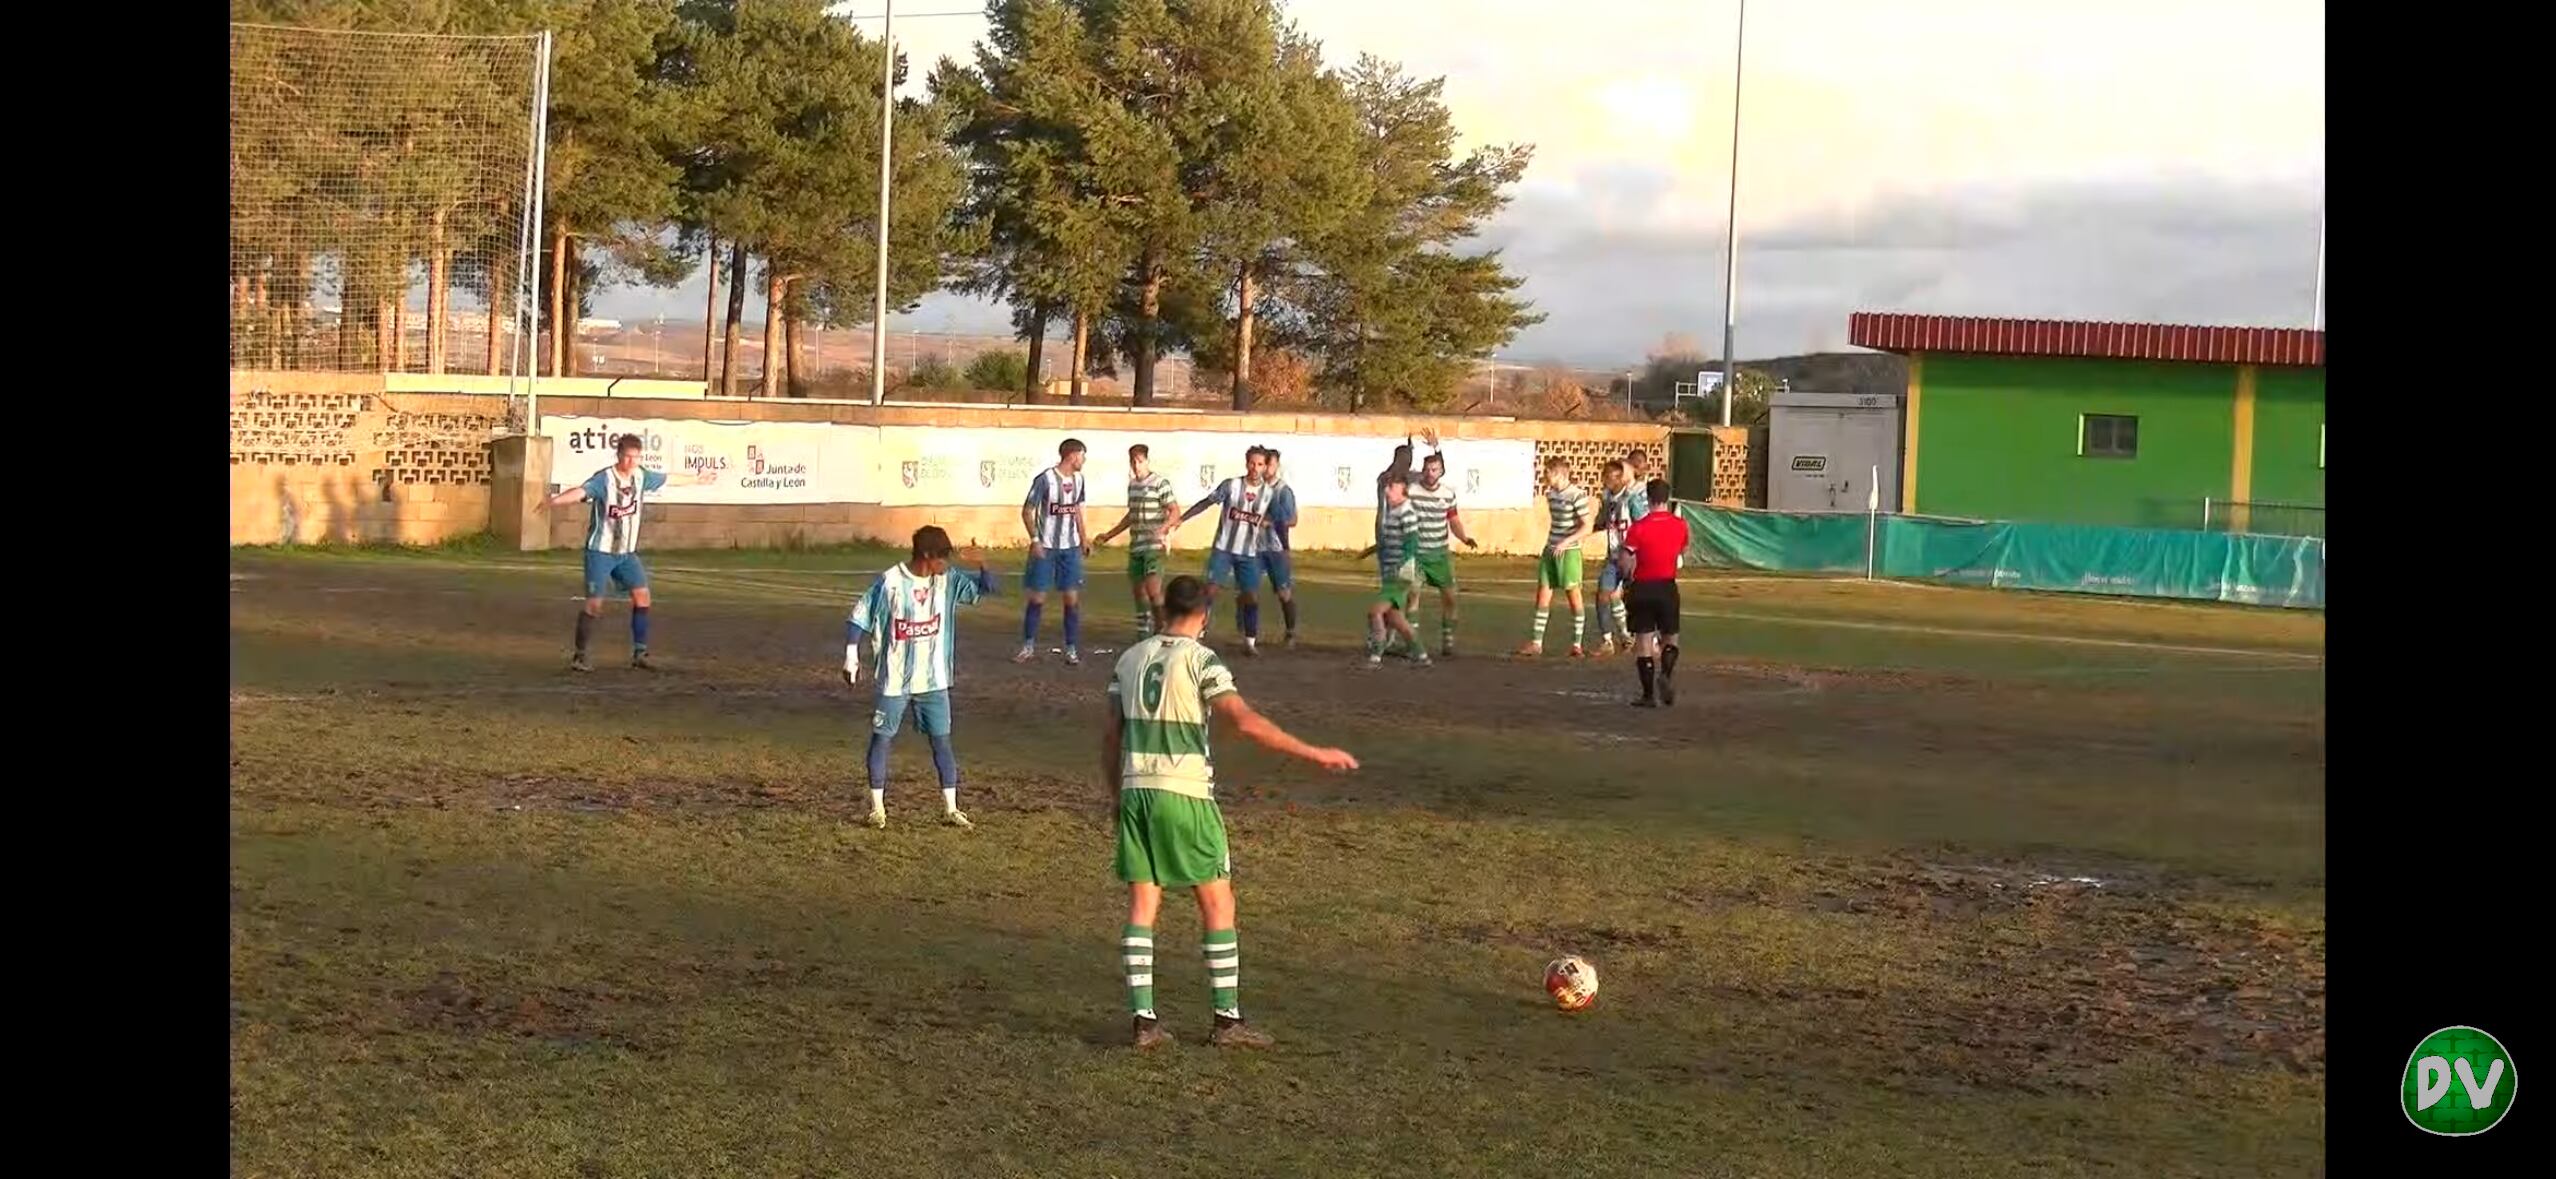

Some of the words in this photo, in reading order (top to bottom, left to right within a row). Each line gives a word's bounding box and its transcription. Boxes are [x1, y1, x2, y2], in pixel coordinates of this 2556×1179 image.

[569, 424, 662, 453] atiedo
[766, 464, 793, 475] Junta
[741, 477, 775, 488] Castilla
[776, 480, 782, 490] y
[1142, 662, 1164, 713] 6
